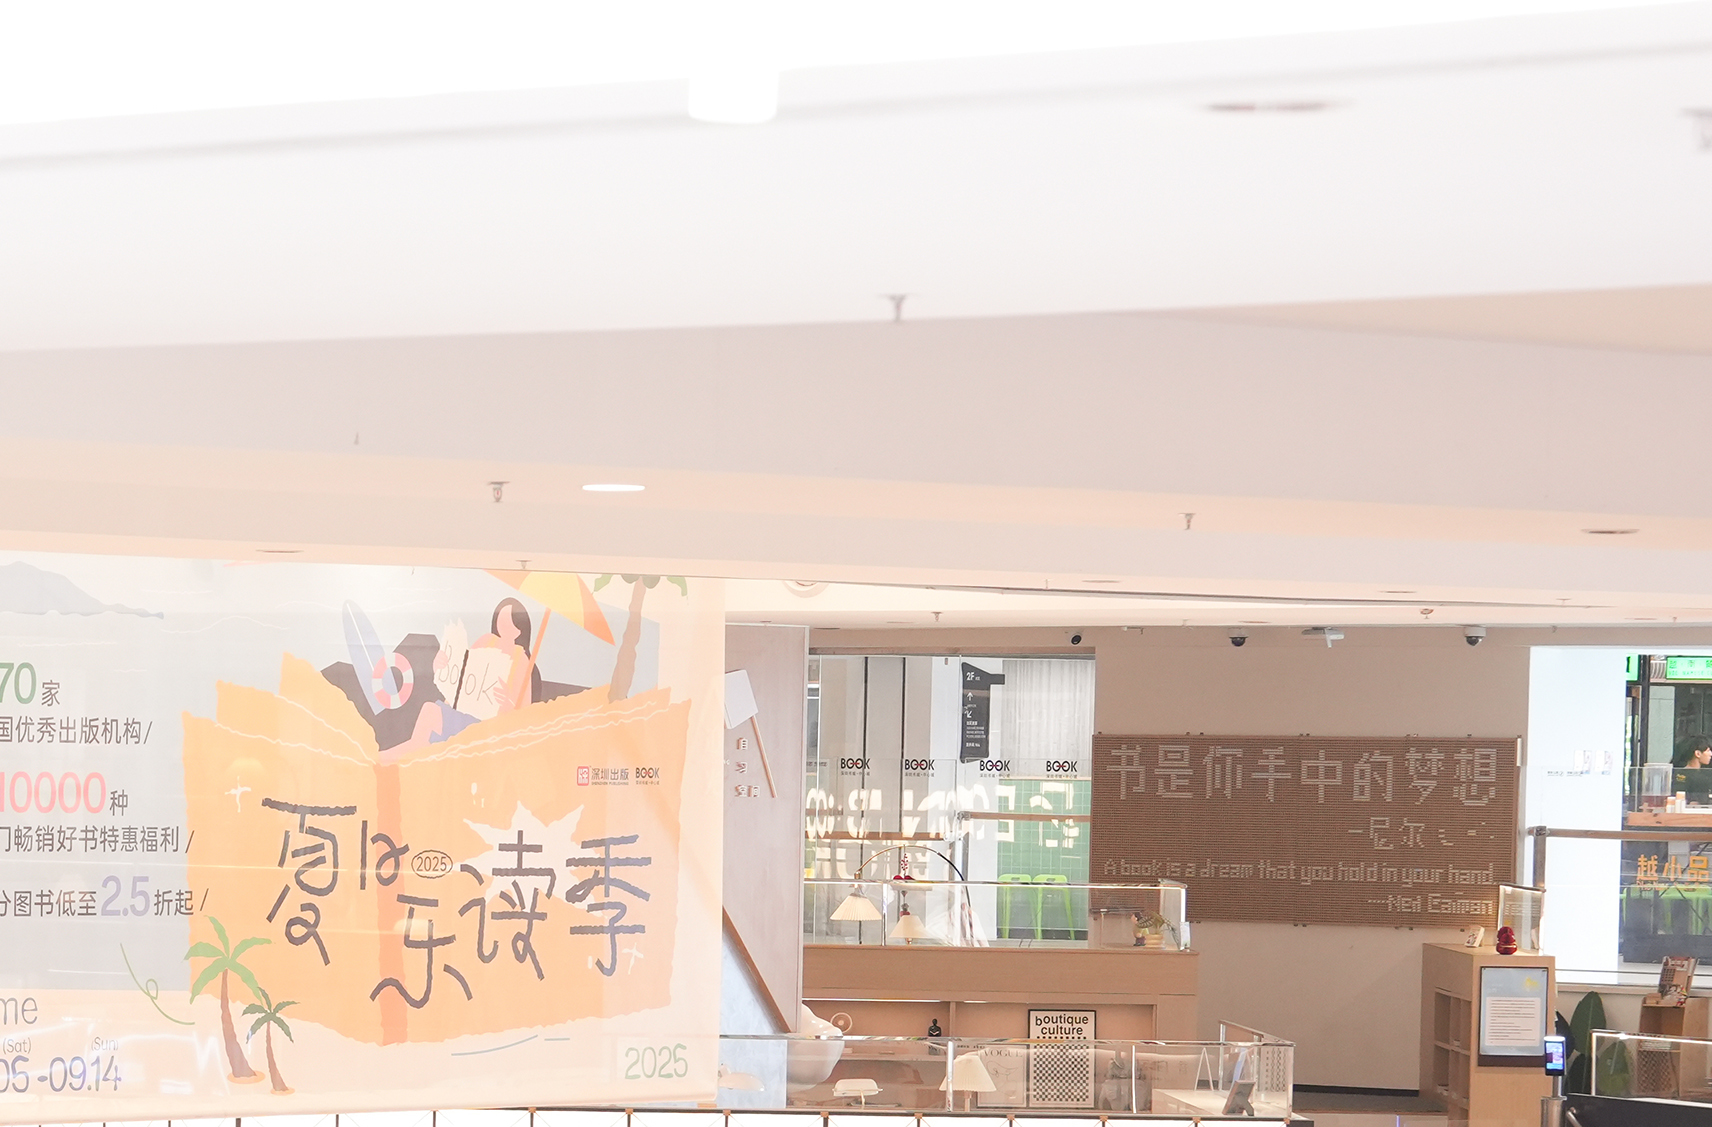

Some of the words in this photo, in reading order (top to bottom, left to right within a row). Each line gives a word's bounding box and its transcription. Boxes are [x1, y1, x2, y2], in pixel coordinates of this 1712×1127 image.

[840, 758, 871, 770] BOOK
[904, 759, 935, 771] BOOK
[979, 760, 1011, 772] BOOK
[1046, 760, 1077, 773] BOOK
[591, 767, 629, 781] 深圳出版
[635, 767, 660, 779] BOOK
[1106, 743, 1498, 807] 书是你手中的梦想
[416, 855, 448, 874] 2025
[1636, 854, 1710, 882] 越小品
[1120, 859, 1162, 876] book
[1165, 858, 1181, 876] is
[1200, 858, 1254, 879] dream
[1257, 859, 1298, 880] that
[1300, 864, 1334, 886] you
[1401, 866, 1445, 888] your
[1035, 1013, 1089, 1028] boutique
[1040, 1024, 1084, 1036] culture
[980, 1048, 1024, 1059] VOGUE
[624, 1043, 689, 1081] 2025
